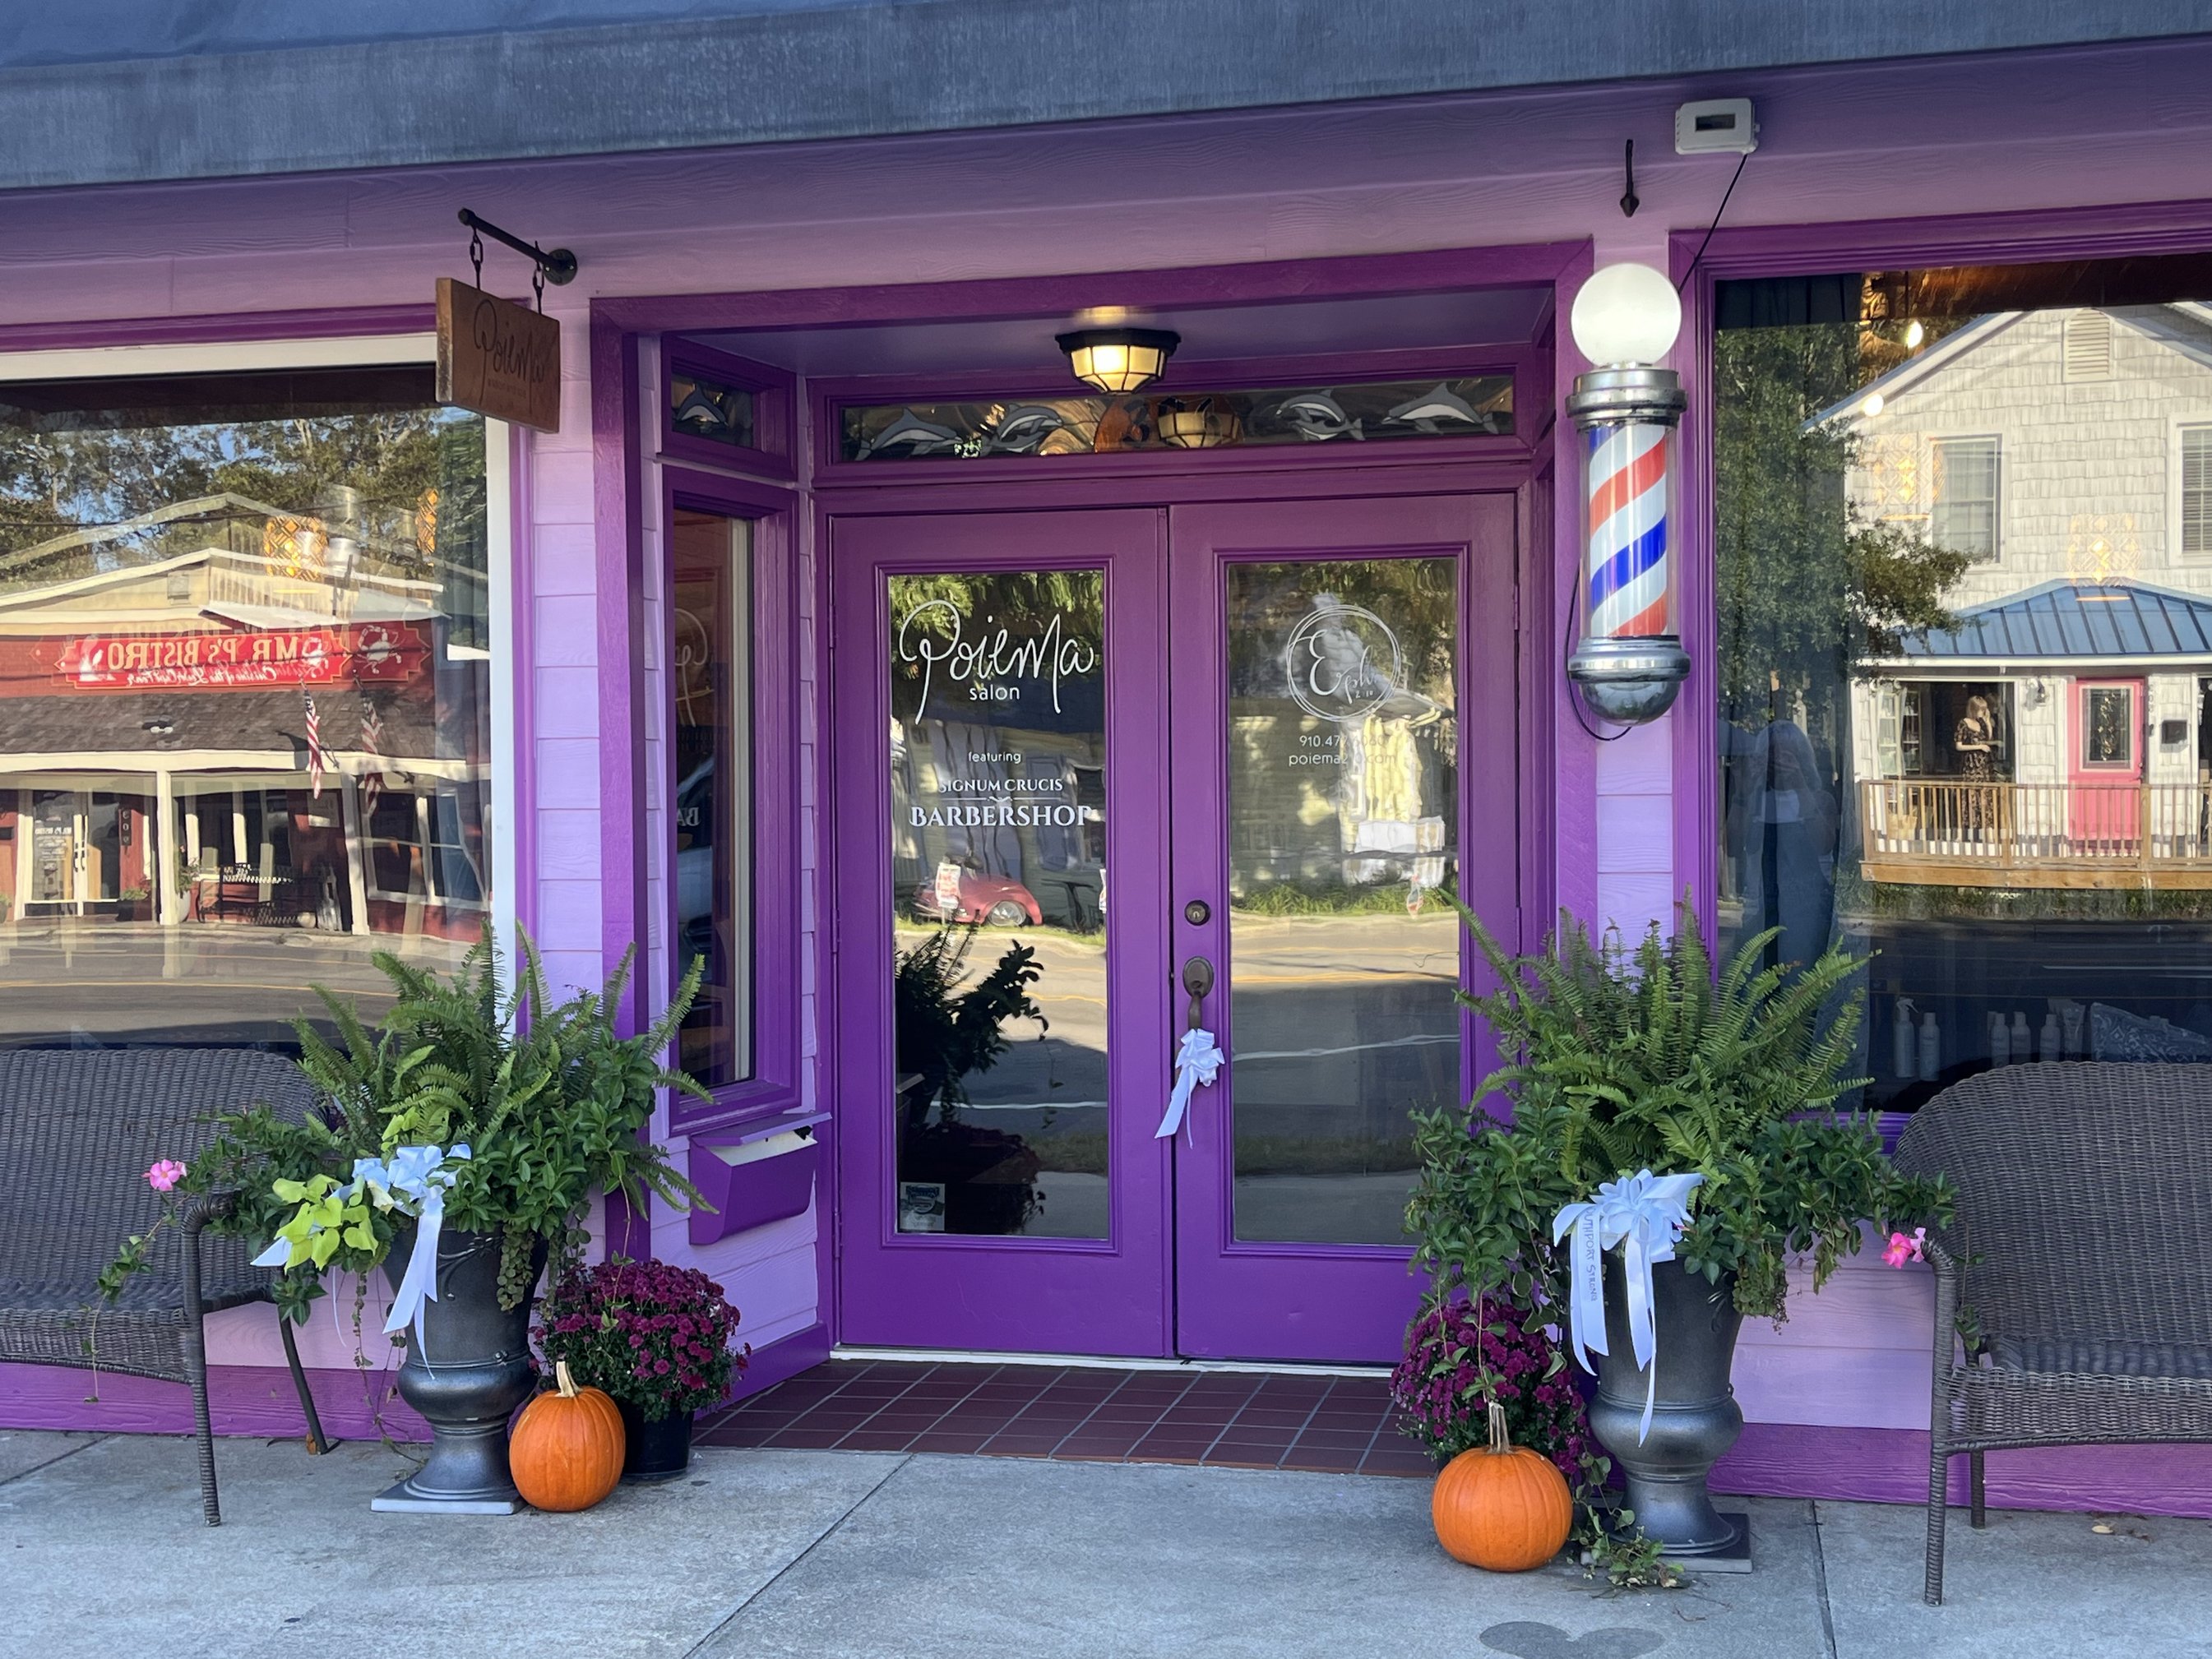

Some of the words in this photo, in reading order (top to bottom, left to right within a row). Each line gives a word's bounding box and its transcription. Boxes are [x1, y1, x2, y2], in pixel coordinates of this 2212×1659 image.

[969, 683, 1020, 700] salon
[968, 751, 1022, 765] featuring
[938, 779, 1002, 793] SIGNUM
[1004, 778, 1063, 792] CRUCIS
[909, 805, 1093, 828] BARBERSHOP
